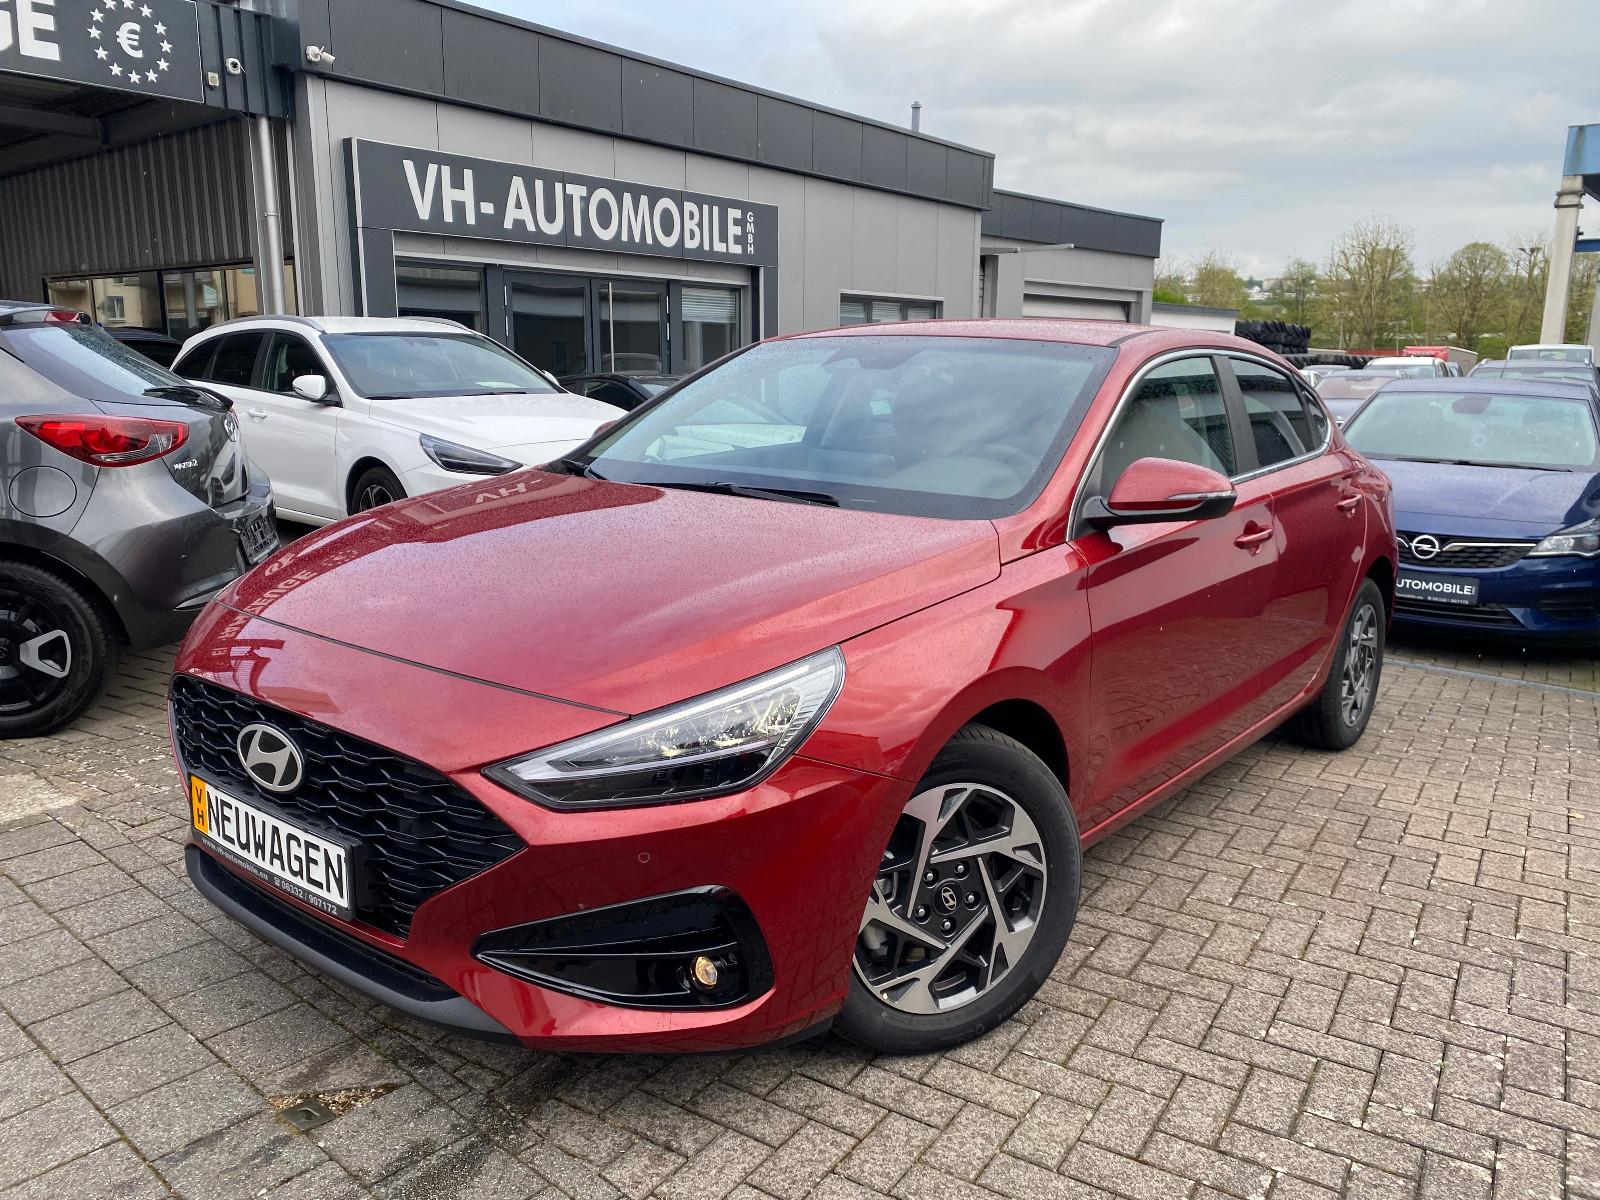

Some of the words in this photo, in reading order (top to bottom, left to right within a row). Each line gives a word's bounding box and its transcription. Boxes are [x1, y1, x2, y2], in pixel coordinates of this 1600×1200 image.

[0, 0, 60, 62] E
[503, 175, 743, 254] AUTOMOBILE
[1395, 577, 1473, 596] UTOMOBILE
[206, 790, 344, 899] NEUWAGEN
[281, 880, 304, 899] 06332
[308, 894, 338, 916] 907172
